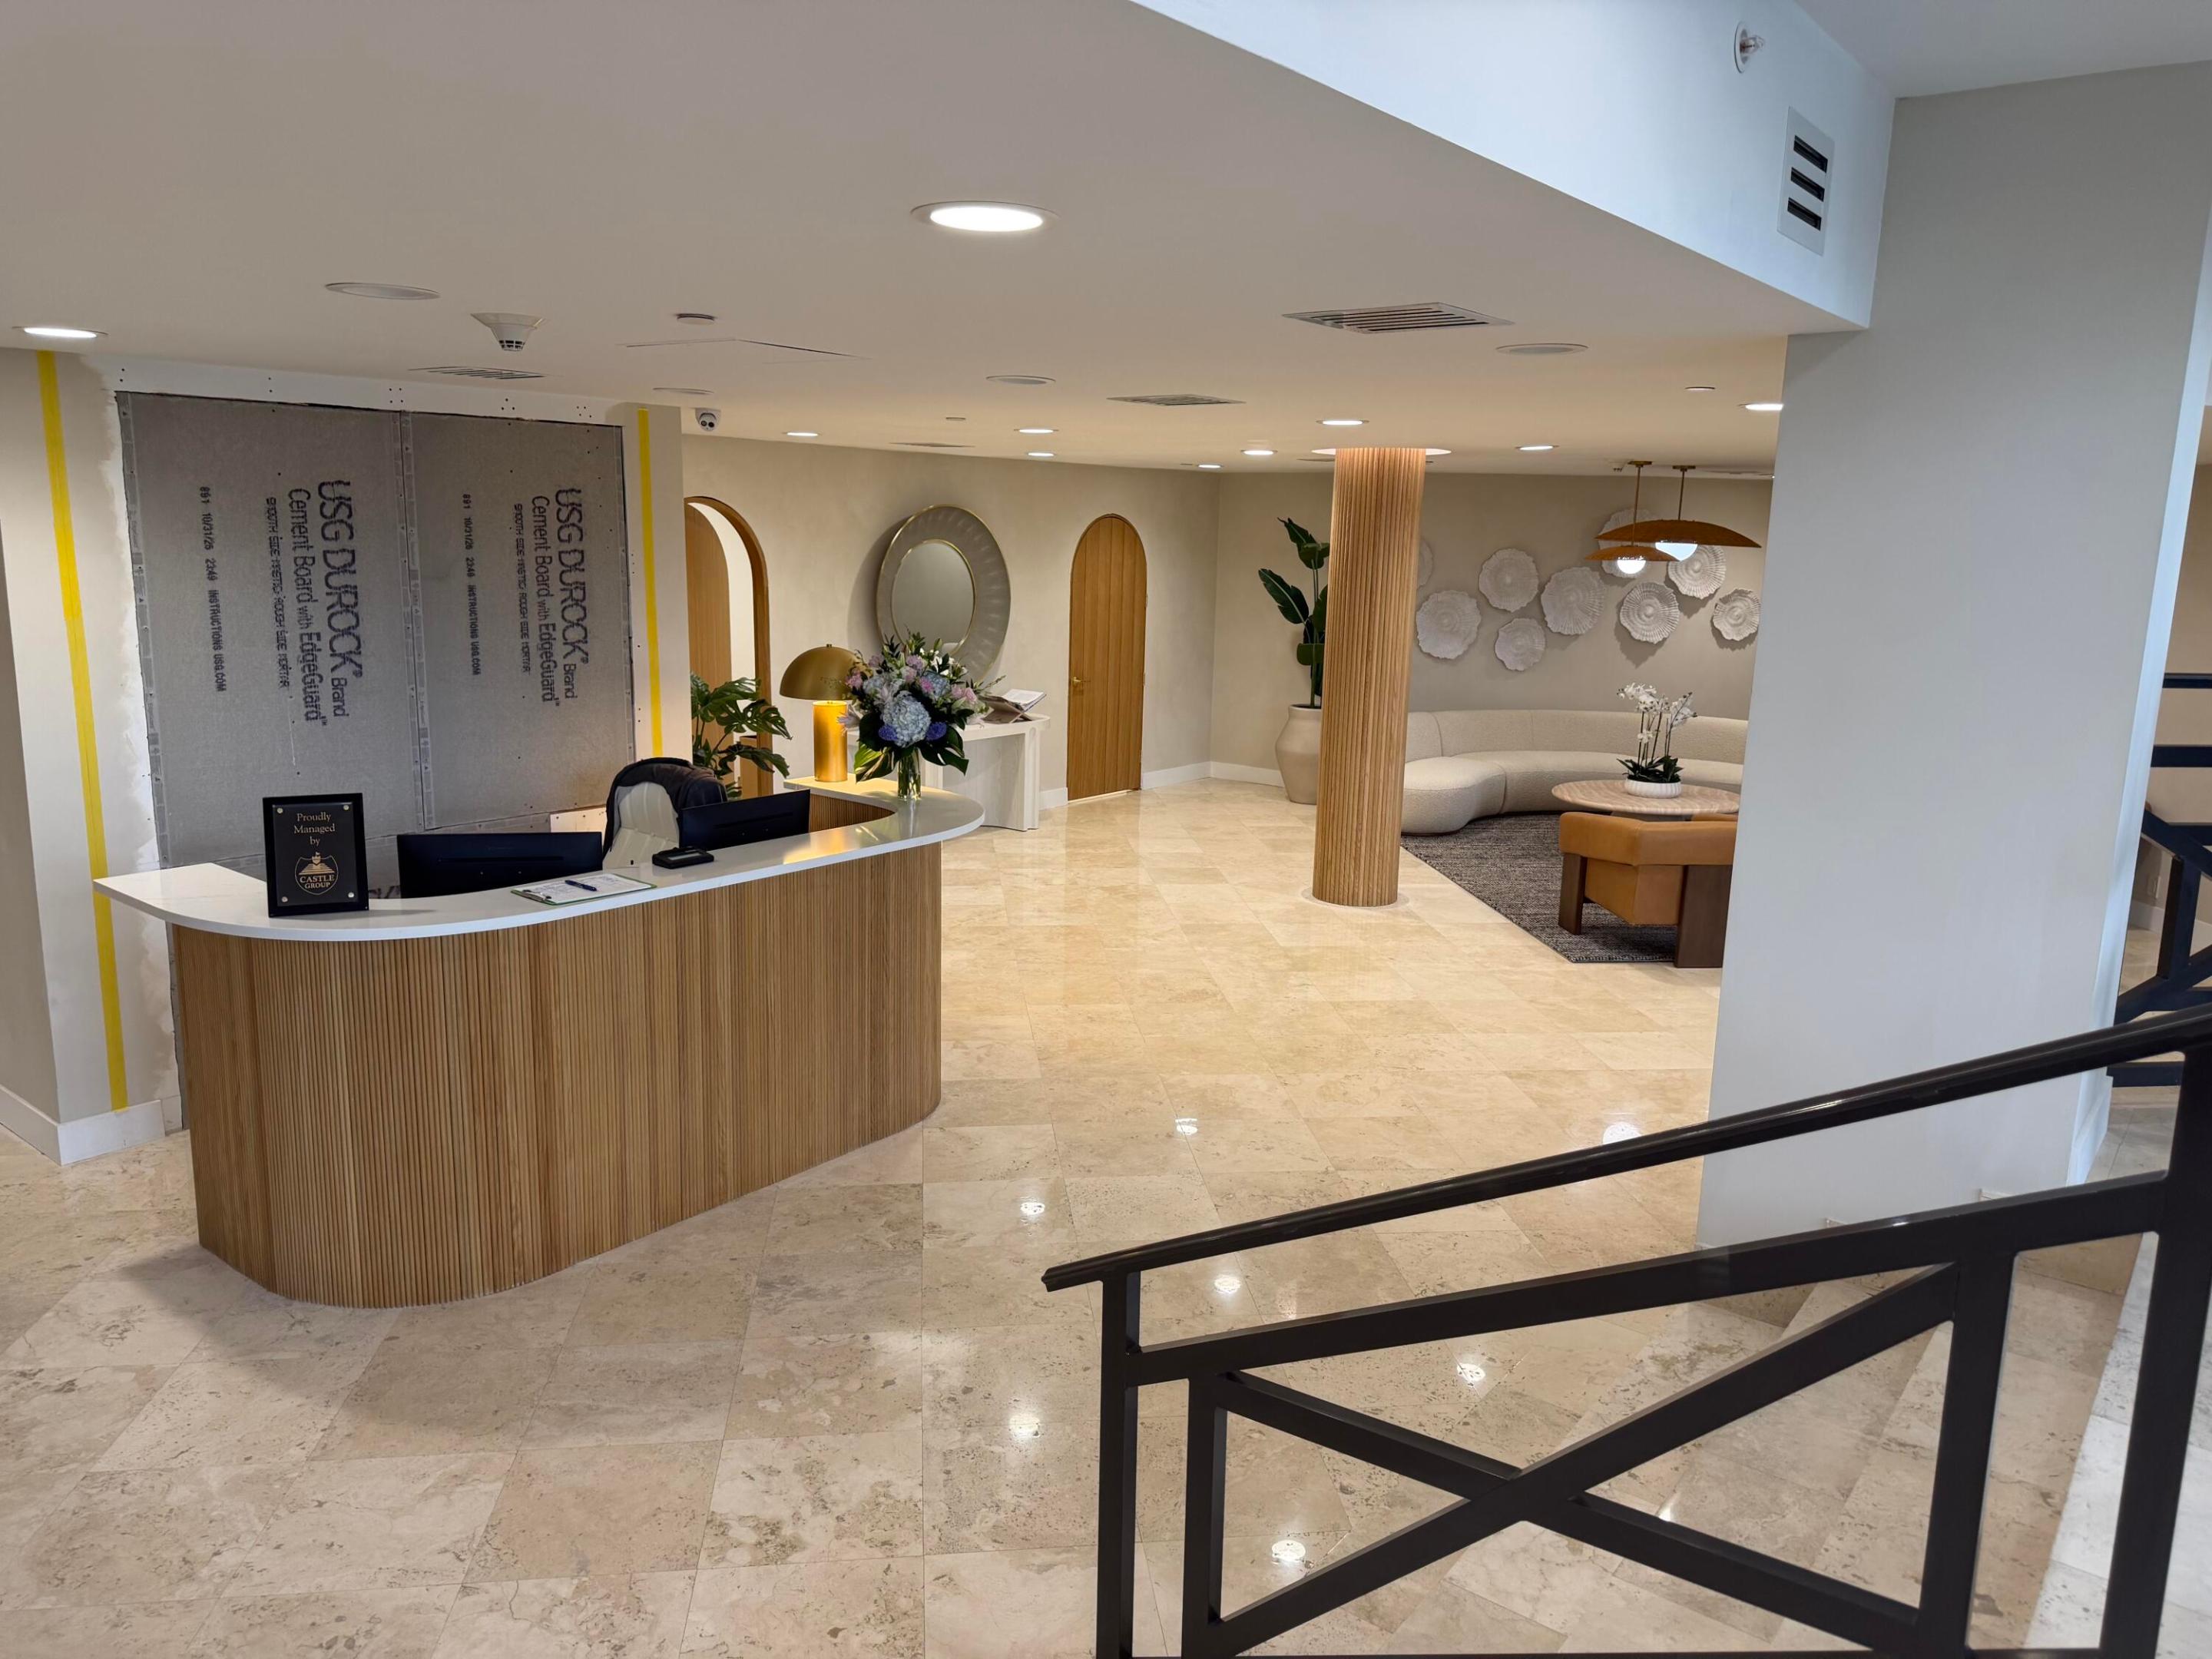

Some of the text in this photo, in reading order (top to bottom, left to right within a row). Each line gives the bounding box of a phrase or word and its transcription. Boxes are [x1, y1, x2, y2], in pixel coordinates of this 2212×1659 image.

[288, 488, 313, 551] Cement
[318, 480, 354, 542] USG
[463, 494, 472, 509] 891
[555, 488, 584, 544] USG
[531, 495, 551, 552] Cement
[293, 556, 318, 603] Board
[535, 555, 554, 598] Board
[208, 590, 223, 651] INSTRUCTIONS
[296, 605, 314, 630] with
[468, 584, 479, 639] INSTRUCTIONS
[537, 600, 551, 621] with
[214, 654, 227, 692] USG.COM
[470, 641, 482, 676] USG.COM
[331, 677, 351, 717] Brand
[563, 664, 578, 699] Brand
[293, 823, 336, 835] Managed
[296, 812, 332, 823] Proudly
[310, 836, 320, 846] by
[300, 874, 335, 883] CASTLE
